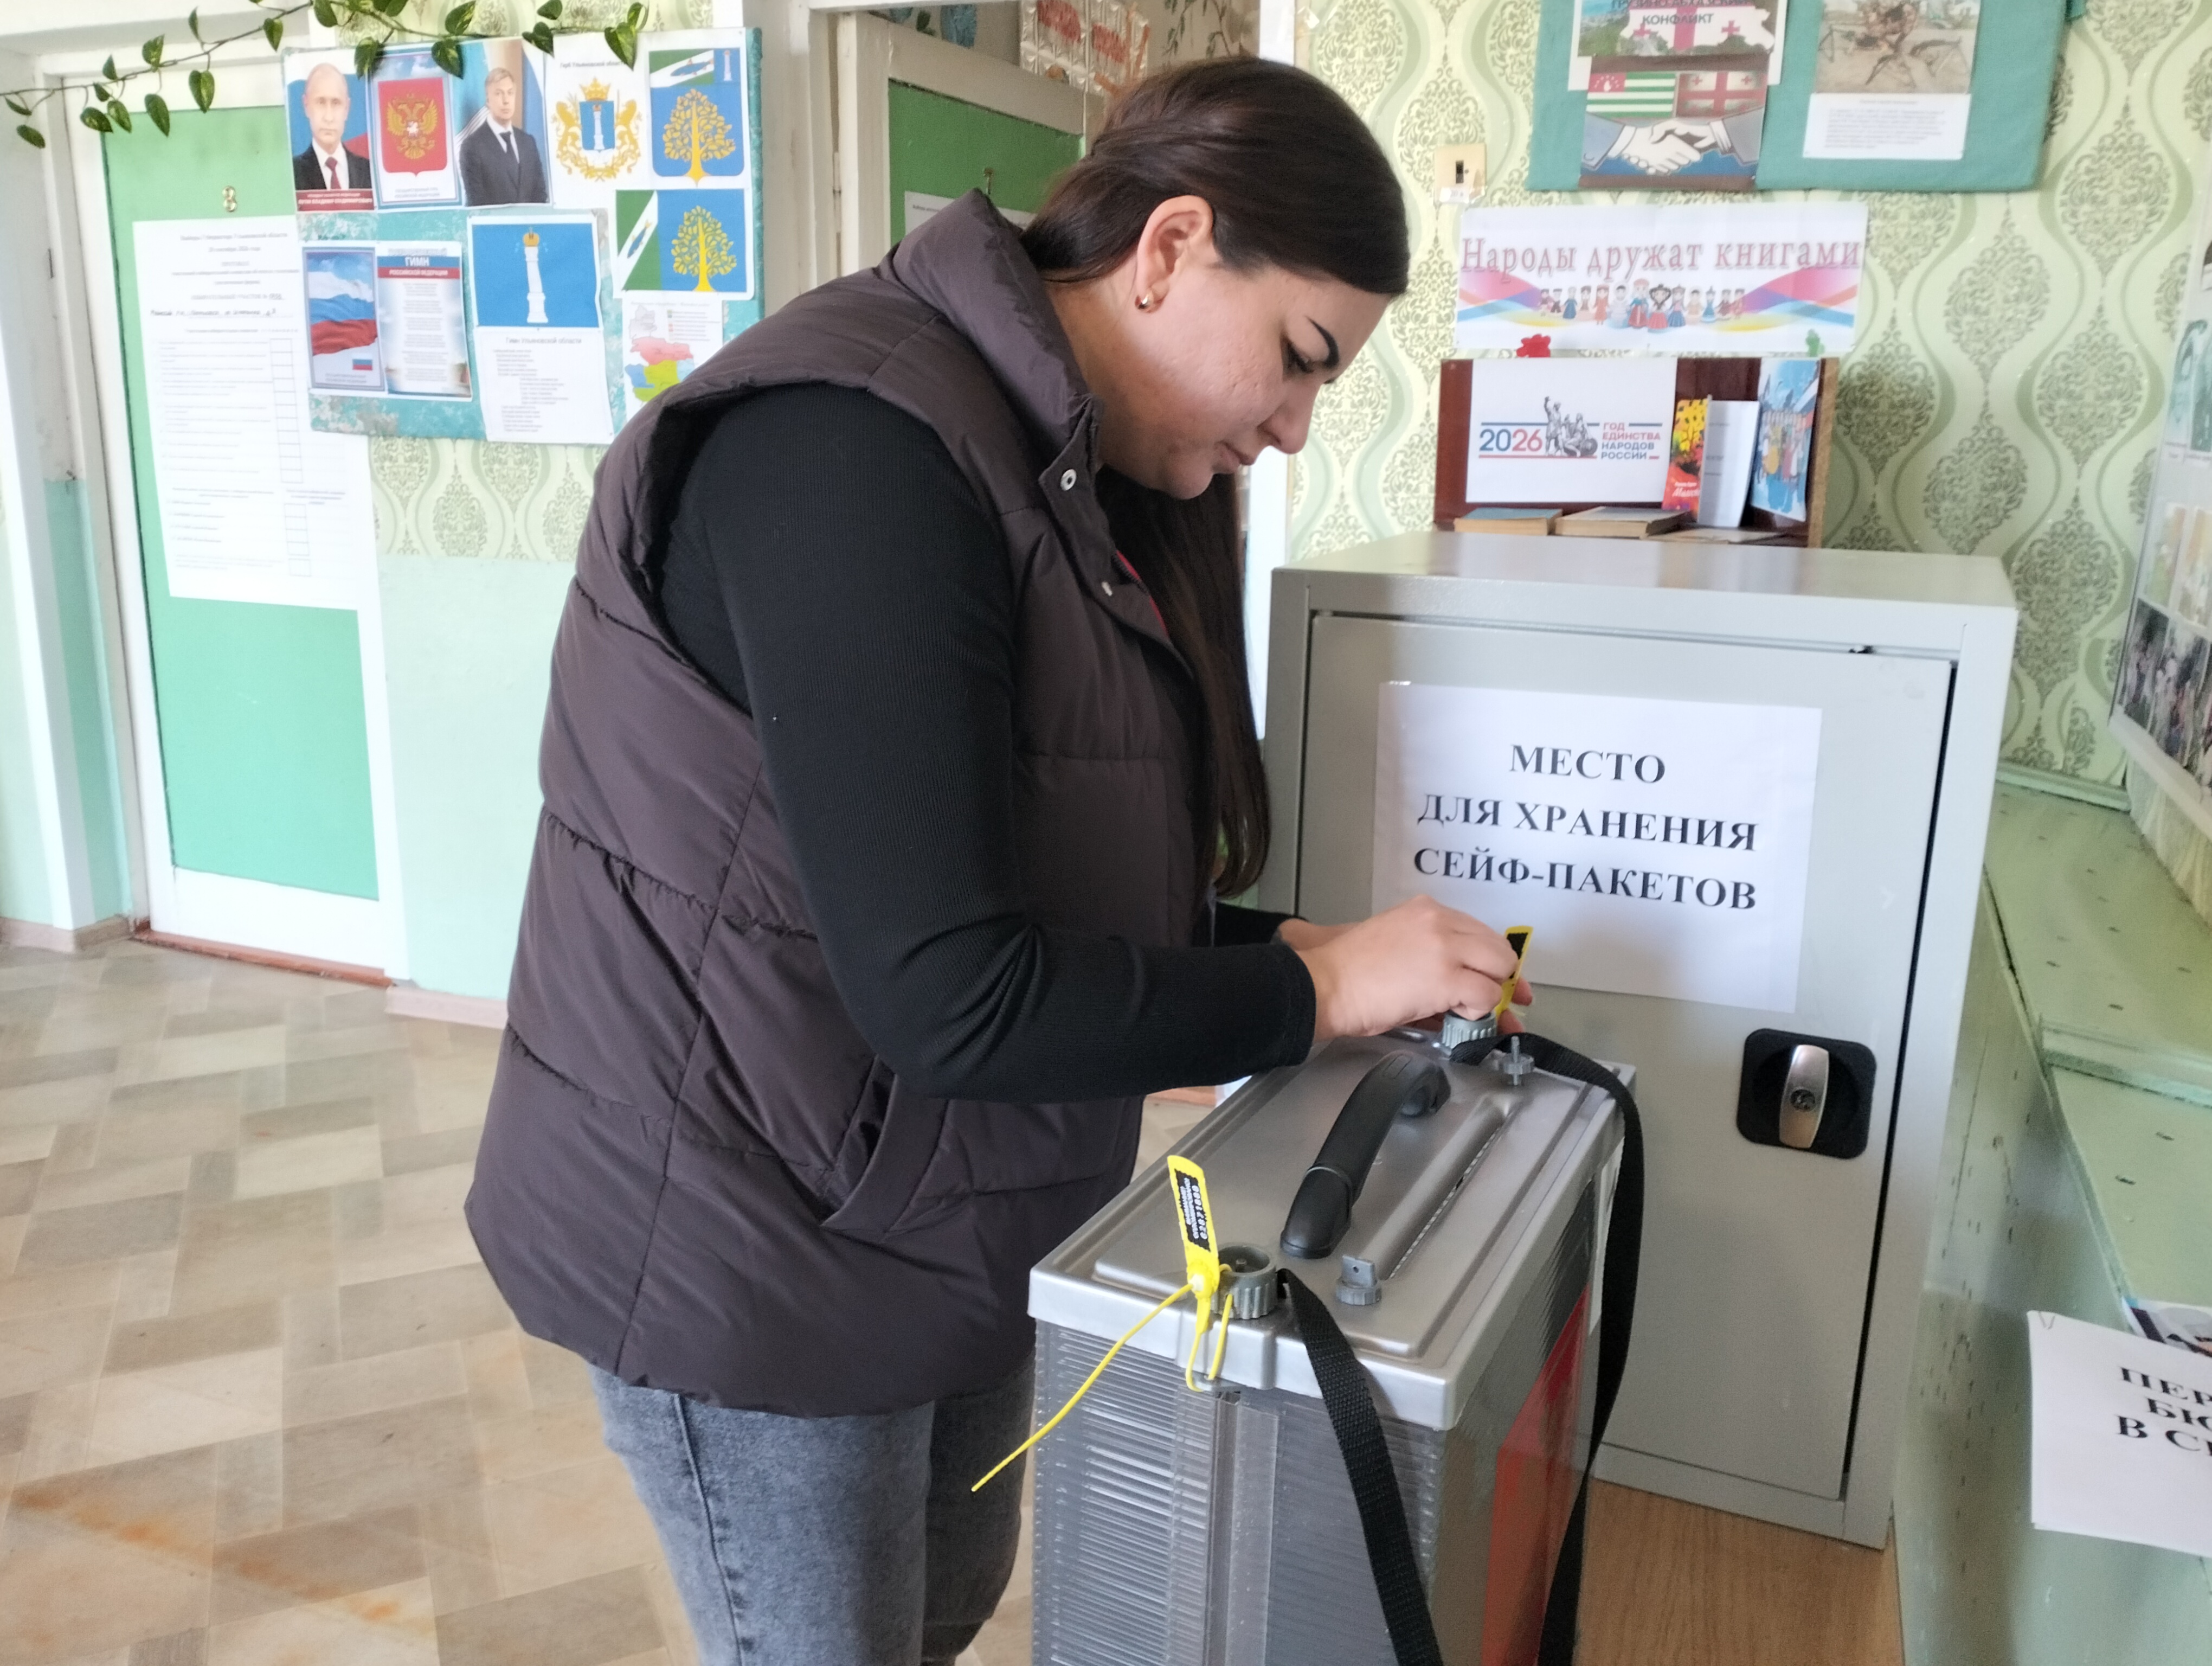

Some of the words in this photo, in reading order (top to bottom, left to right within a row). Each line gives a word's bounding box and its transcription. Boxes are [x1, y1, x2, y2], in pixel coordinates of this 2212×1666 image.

[1642, 13, 1714, 25] КОНФЛИКТ
[405, 257, 429, 266] ГИМН
[1461, 238, 1577, 283] Народы
[1587, 243, 1703, 283] дружат
[1714, 241, 1862, 270] книгами
[1603, 422, 1625, 431] ГОД
[1479, 428, 1543, 452] 2026
[1602, 432, 1661, 441] ЕДИНСТВА
[1601, 451, 1647, 460] РОССИИ
[1602, 442, 1654, 451] НАРОДОВ
[1509, 745, 1666, 784] МЕСТО
[1417, 793, 1503, 827] ДЛЯ
[1514, 801, 1759, 852] ХРАНЕНИЯ
[1413, 847, 1757, 911] СЕЙФ-ПАКЕТОВ
[2115, 1414, 2149, 1438] В
[2165, 1430, 2212, 1457] С
